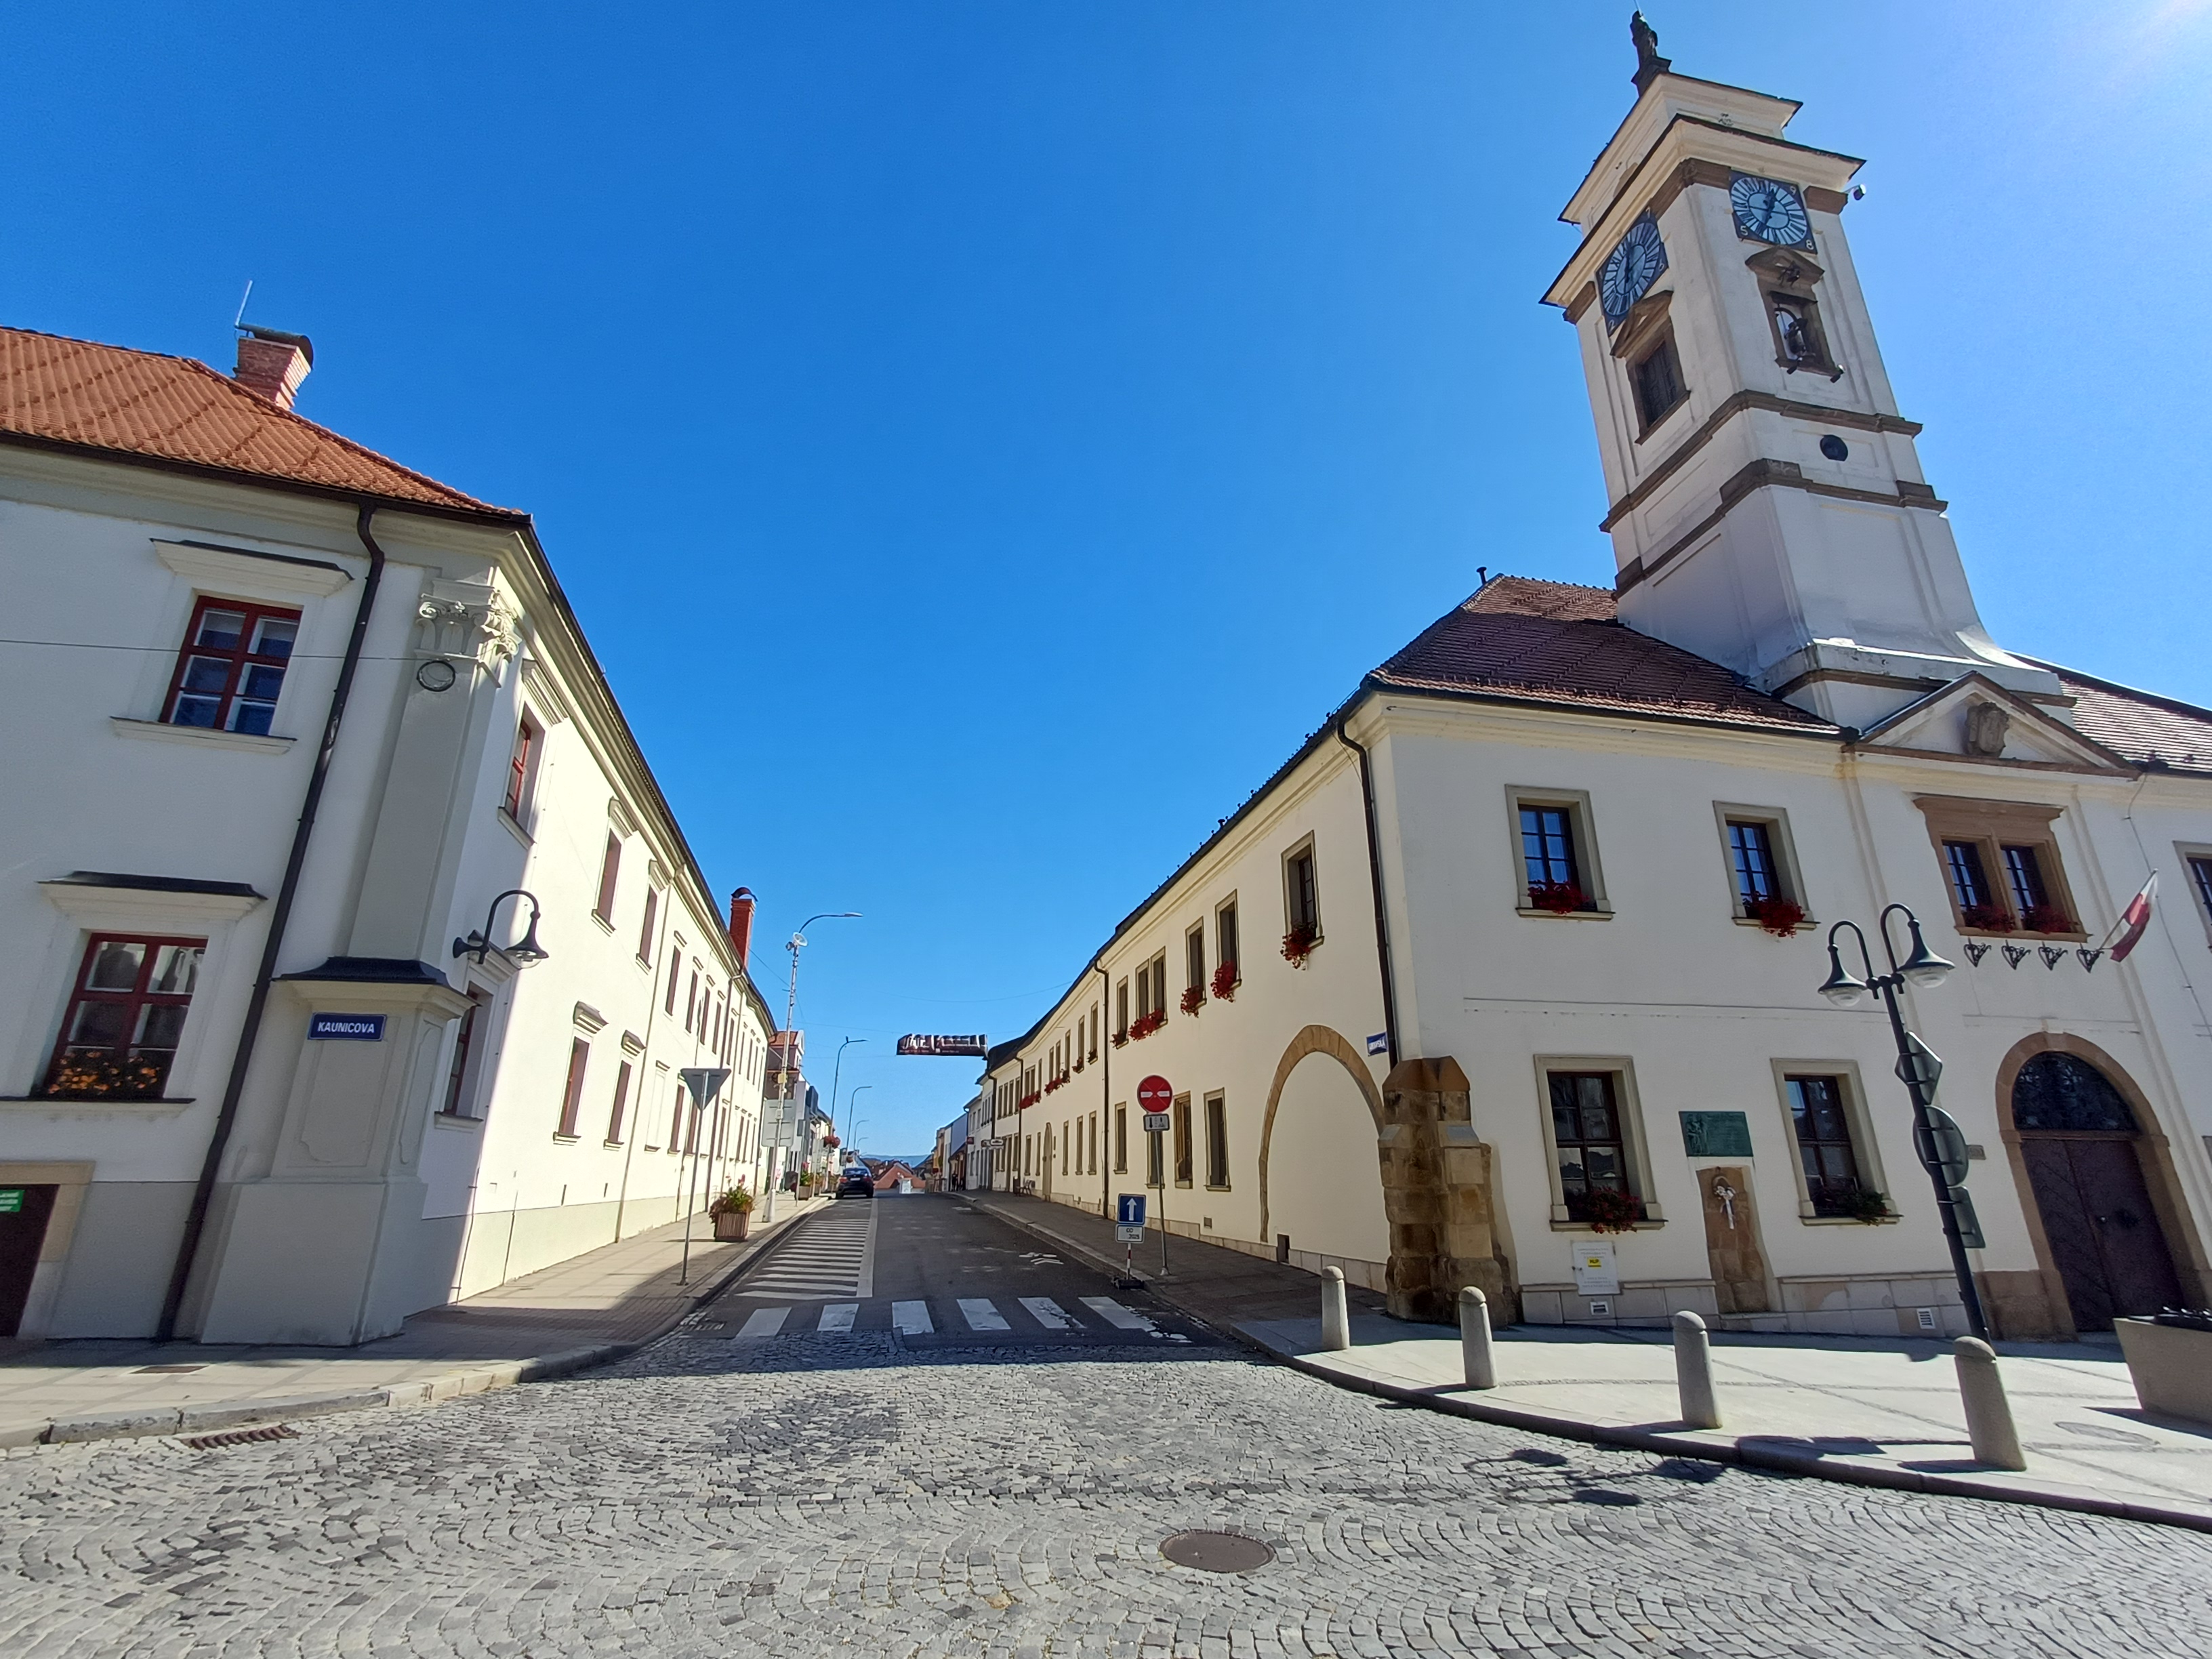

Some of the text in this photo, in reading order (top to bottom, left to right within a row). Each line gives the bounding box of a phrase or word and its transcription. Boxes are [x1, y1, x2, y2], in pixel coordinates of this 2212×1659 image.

[1790, 186, 1797, 194] 9
[1740, 226, 1748, 236] 5
[1805, 239, 1814, 249] 8
[1609, 319, 1616, 331] 2
[317, 1021, 375, 1033] KAUNICOVA
